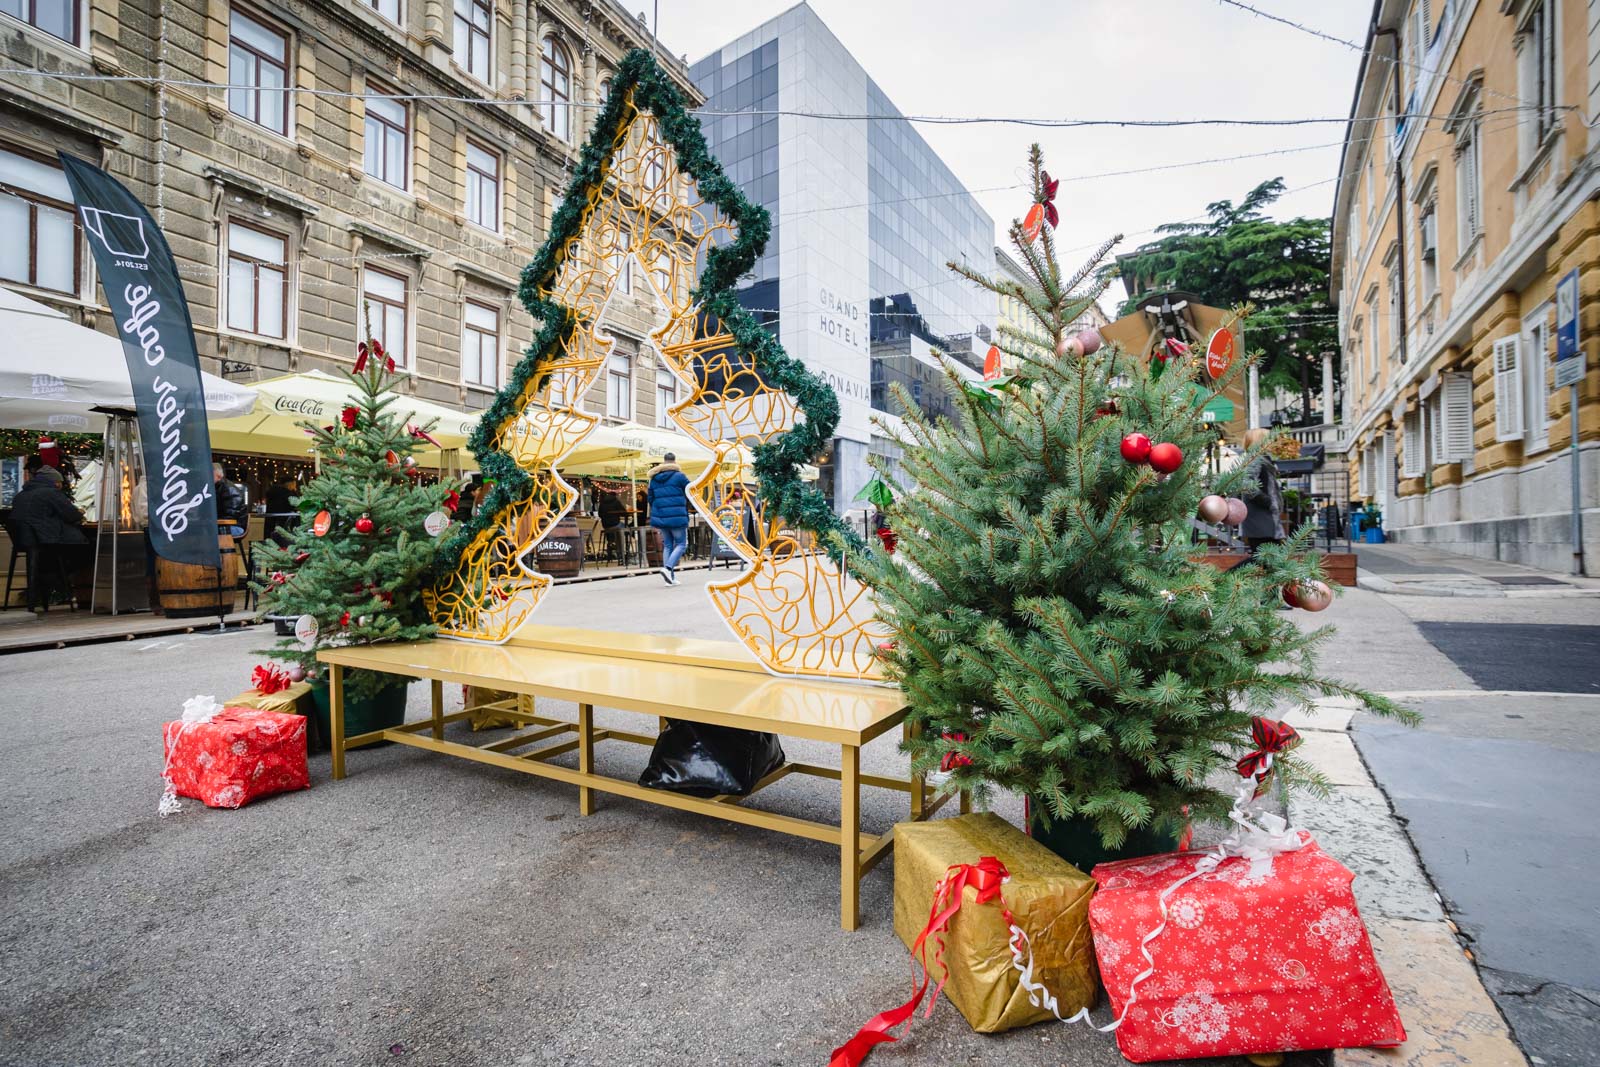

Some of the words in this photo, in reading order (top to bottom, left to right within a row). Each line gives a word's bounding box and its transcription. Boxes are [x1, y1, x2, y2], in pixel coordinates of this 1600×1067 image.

[820, 287, 858, 321] GRAND
[820, 314, 858, 347] HOTEL
[820, 370, 870, 401] BONAVIA
